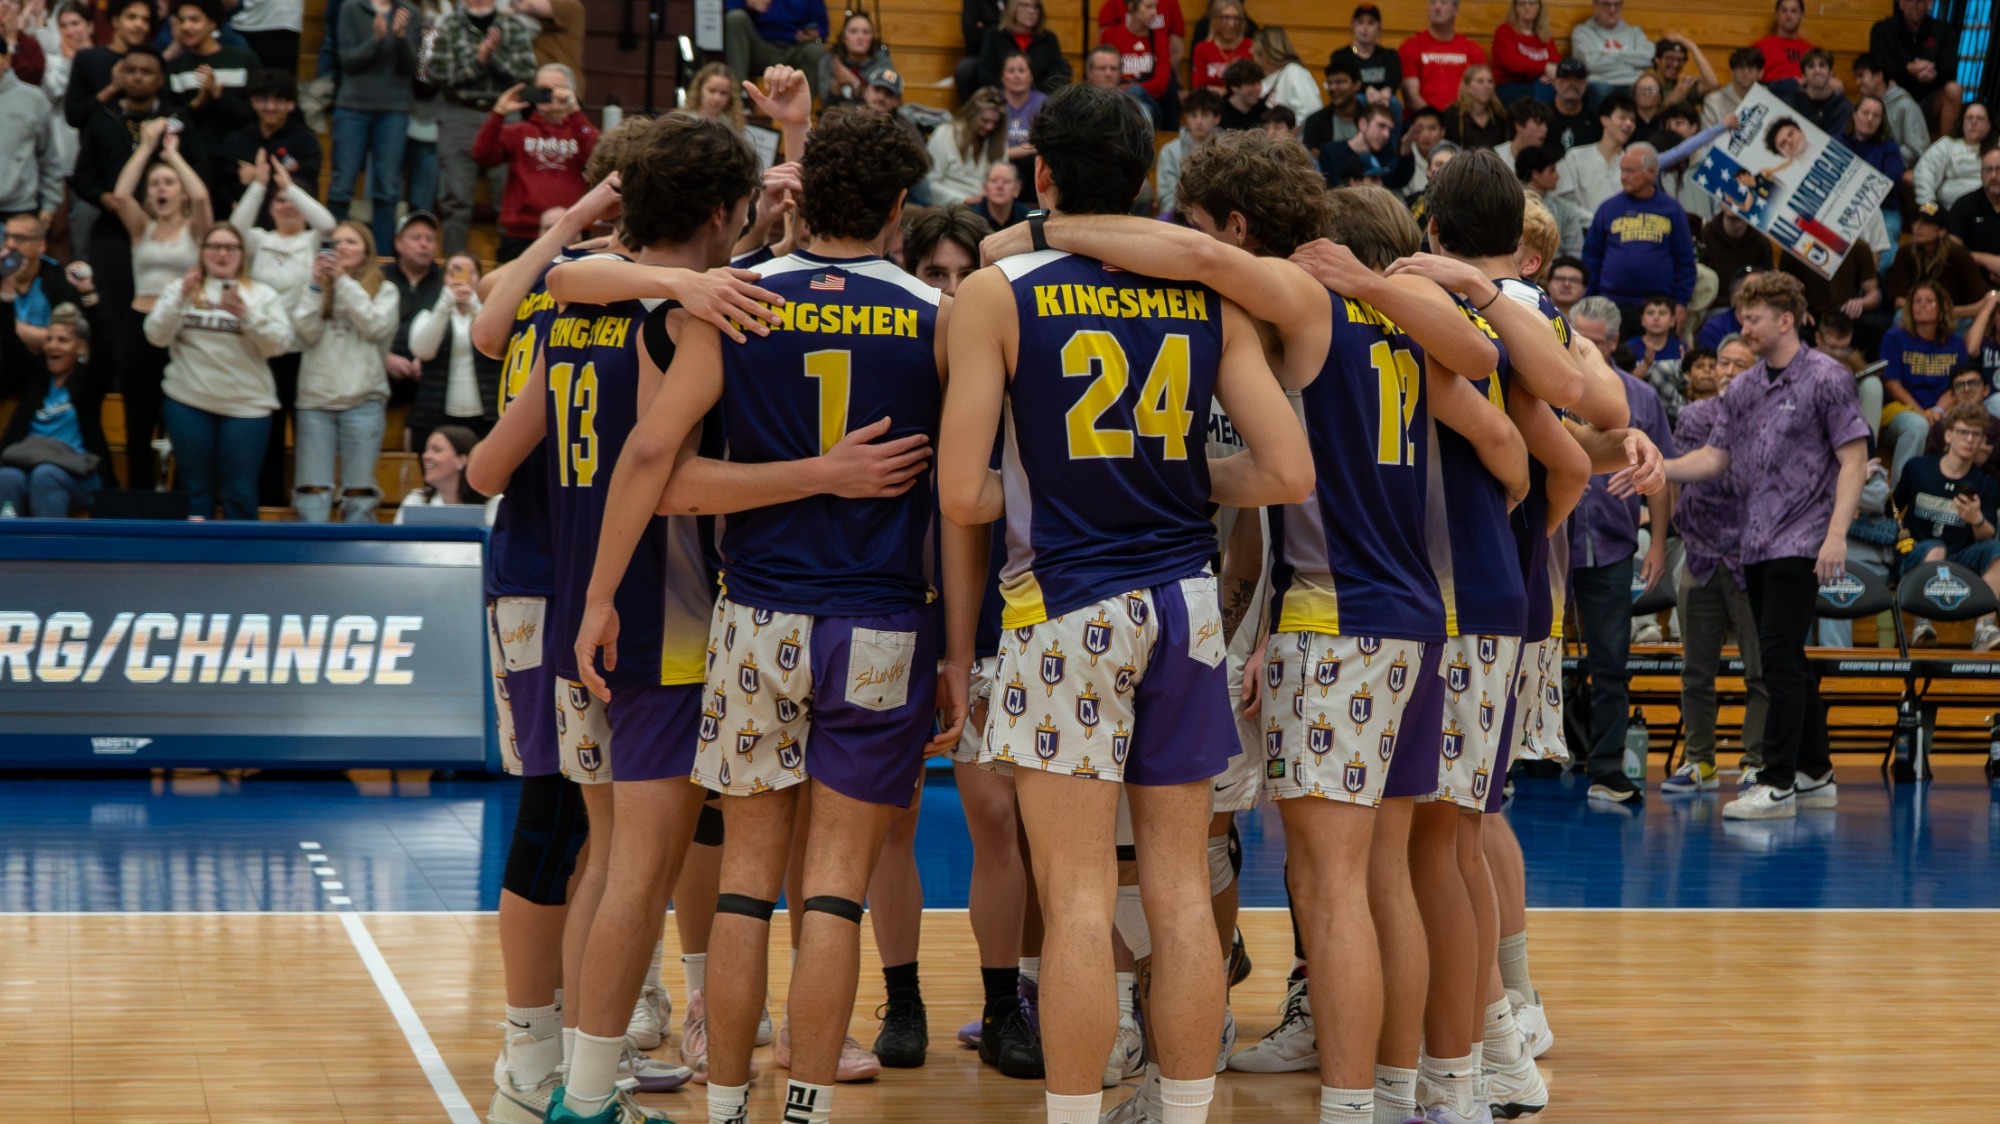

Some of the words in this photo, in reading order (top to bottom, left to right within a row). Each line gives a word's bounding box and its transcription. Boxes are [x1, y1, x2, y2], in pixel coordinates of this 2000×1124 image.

[1784, 138, 1856, 221] AMERICAN
[1033, 284, 1209, 321] KINGSMEN
[730, 300, 918, 338] NGSMEN
[803, 349, 852, 457] 1
[1061, 329, 1194, 461] 24
[1370, 340, 1419, 466] 12
[549, 362, 598, 487] 13
[1086, 625, 1106, 653] CL
[1480, 638, 1495, 662] CL
[780, 645, 796, 668] CL
[1839, 661, 1879, 671] CHAMPIONS
[1880, 661, 1893, 671] WIN
[1894, 661, 1912, 671] HERE
[1952, 663, 1990, 674] CHAMPIONS
[741, 667, 757, 691] CL
[1044, 656, 1061, 683] CL
[1269, 664, 1281, 687] CL
[1318, 663, 1335, 685] CL
[1389, 667, 1403, 691] CL
[1450, 668, 1466, 692] CL
[1008, 688, 1024, 713] CL
[1080, 699, 1098, 725] CL
[1352, 698, 1368, 723] CL
[700, 715, 716, 740] CL
[1038, 732, 1054, 758] CL
[1114, 737, 1126, 763] CL
[1267, 732, 1280, 756] CL
[1309, 729, 1329, 754] CL
[1444, 737, 1459, 759] CL
[580, 750, 599, 770] CL
[779, 747, 801, 768] CL
[1346, 768, 1362, 792] CL
[1474, 775, 1485, 799] CL
